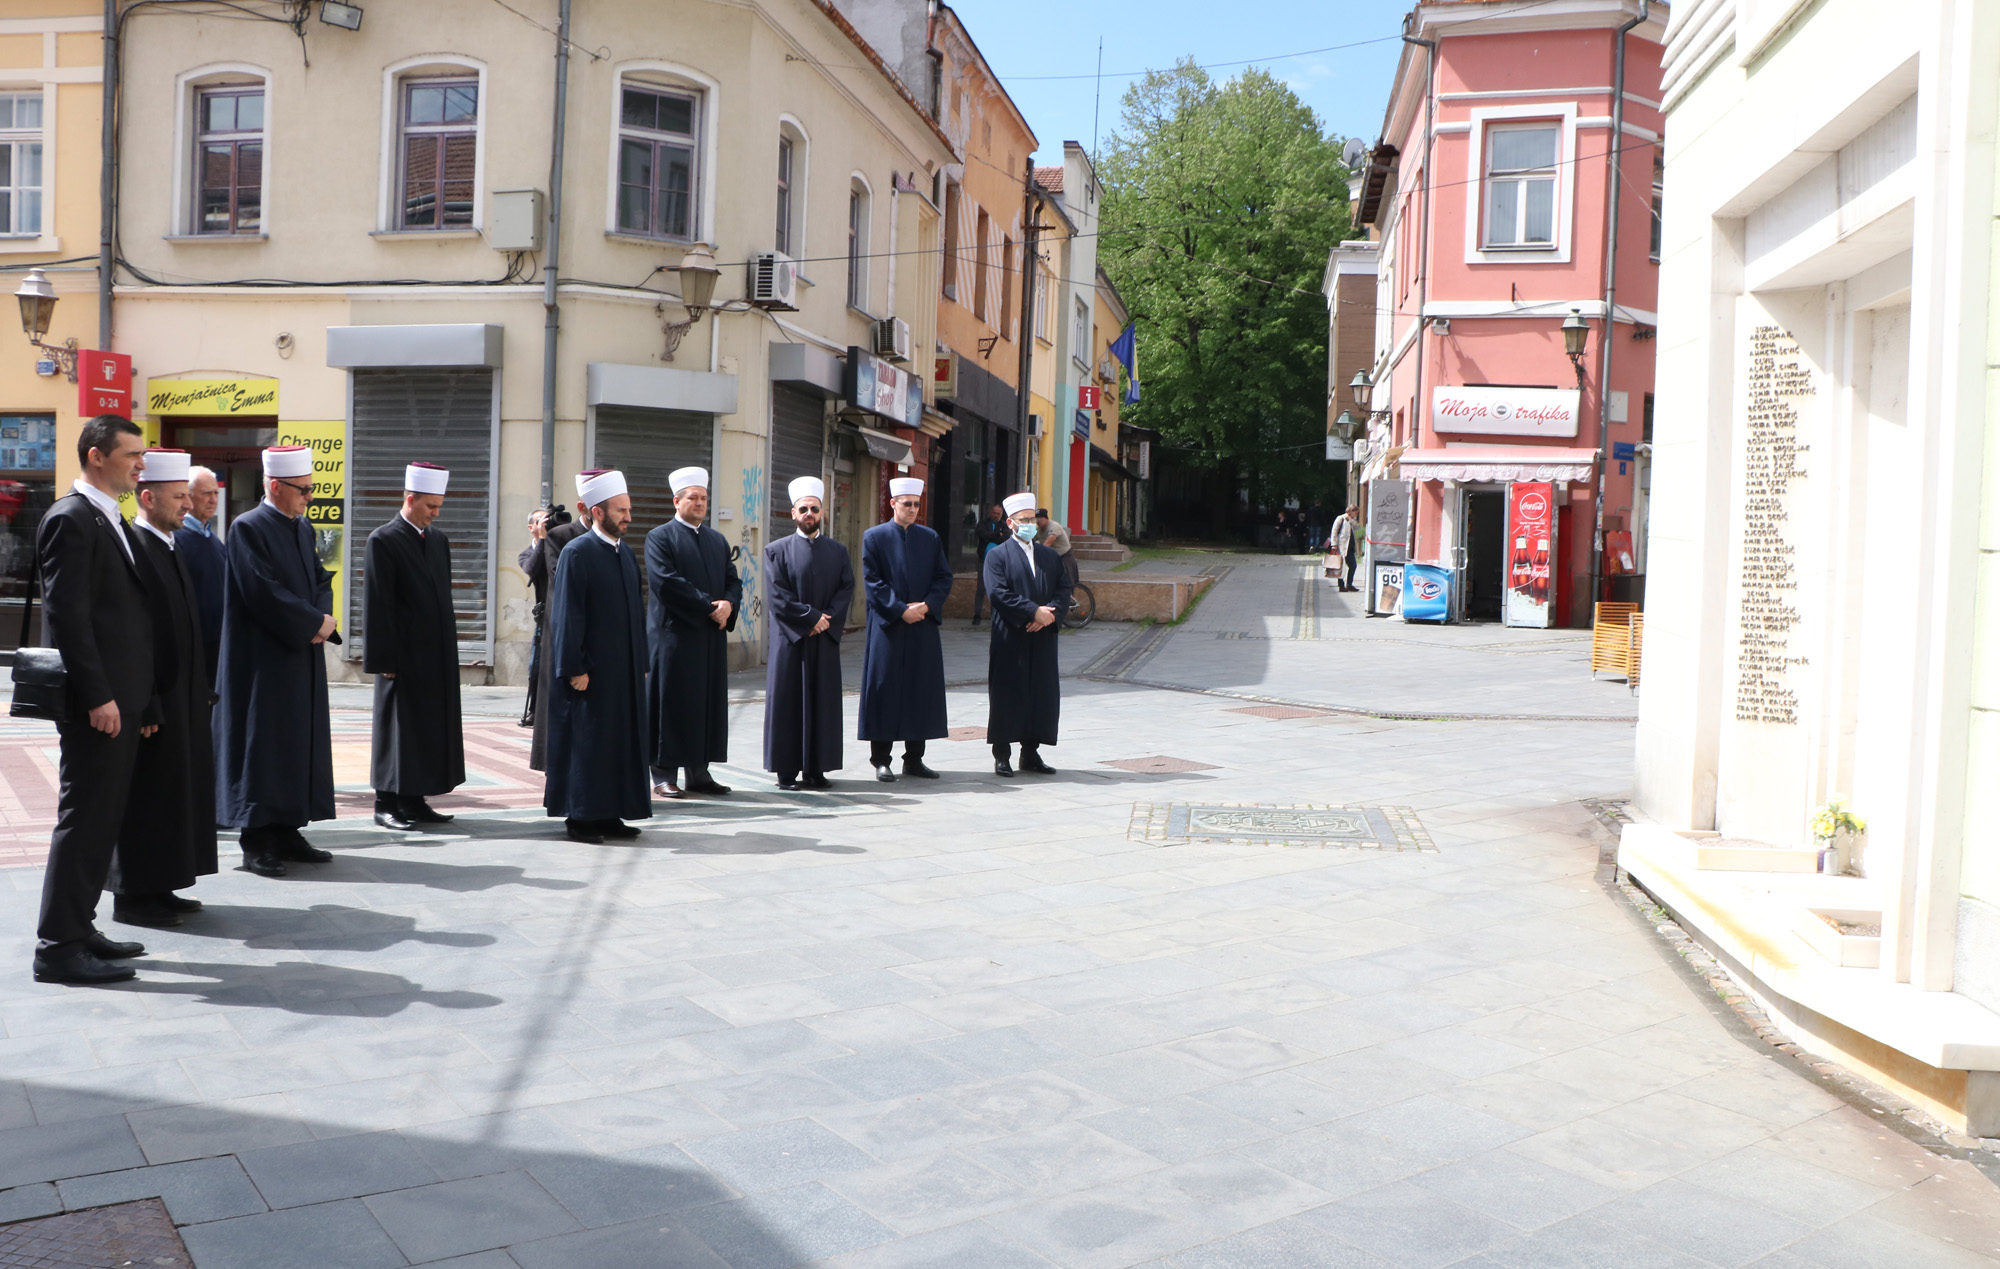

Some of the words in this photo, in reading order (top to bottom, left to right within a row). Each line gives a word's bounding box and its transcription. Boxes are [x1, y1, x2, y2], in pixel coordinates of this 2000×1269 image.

[98, 397, 119, 408] 0-24
[150, 381, 238, 411] Mjenjačnica
[230, 389, 276, 412] Emma
[877, 388, 895, 411] Shop
[1085, 388, 1093, 407] i
[1440, 398, 1489, 422] Moja
[1515, 404, 1571, 425] trafika
[280, 435, 343, 454] Change
[312, 460, 344, 472] our
[1521, 501, 1544, 511] Coca-Cola
[1382, 571, 1403, 586] go!
